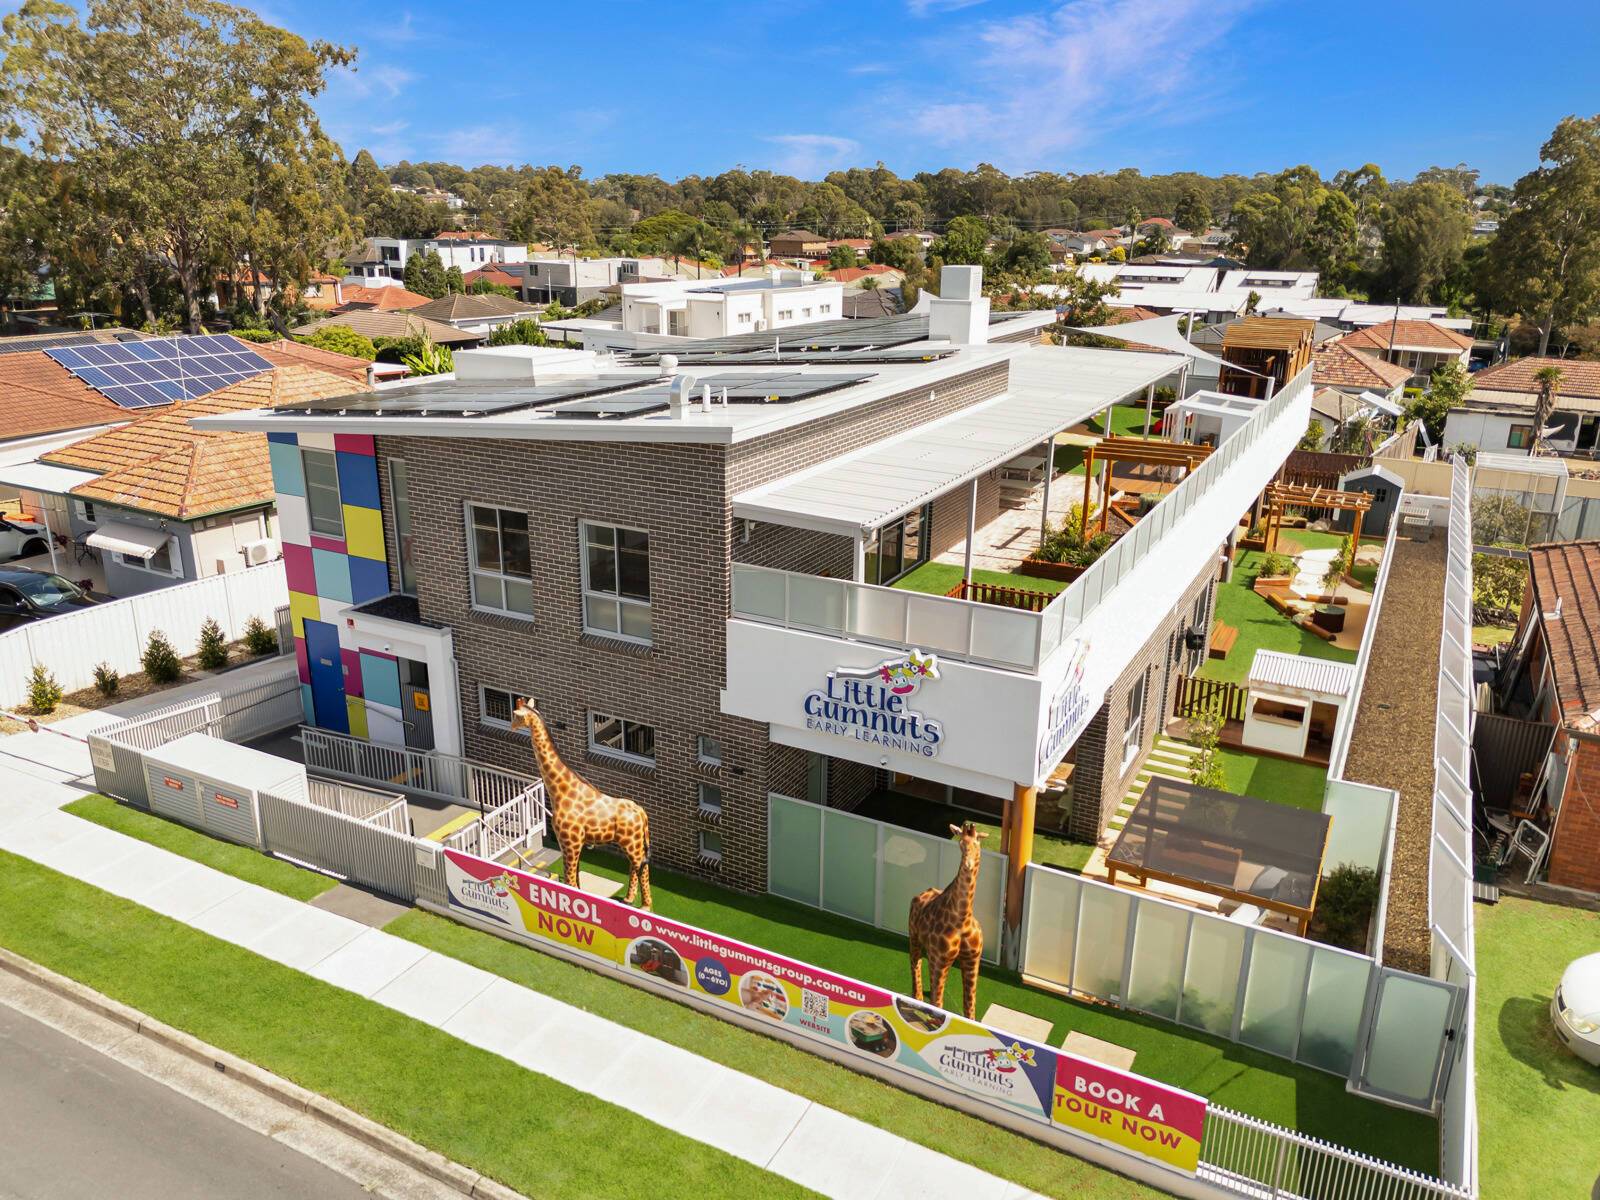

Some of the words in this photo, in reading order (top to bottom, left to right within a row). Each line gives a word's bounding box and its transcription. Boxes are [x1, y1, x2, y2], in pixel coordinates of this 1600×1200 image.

[827, 676, 903, 714] Little
[804, 694, 940, 744] Gumnuts
[806, 718, 848, 735] EARLY
[855, 729, 933, 757] LEARNING
[529, 883, 602, 925] ENROL
[538, 911, 595, 946] NOW
[655, 924, 866, 1002] www.littlegumnutsgroup.com.au
[703, 966, 722, 978] AGES
[799, 1018, 832, 1034] WEBSITE
[939, 1053, 1014, 1089] Gumnuts
[1074, 1075, 1142, 1112] BOOK
[1147, 1103, 1165, 1121] A
[1055, 1093, 1113, 1124] TOUR
[1121, 1116, 1182, 1149] NOW
